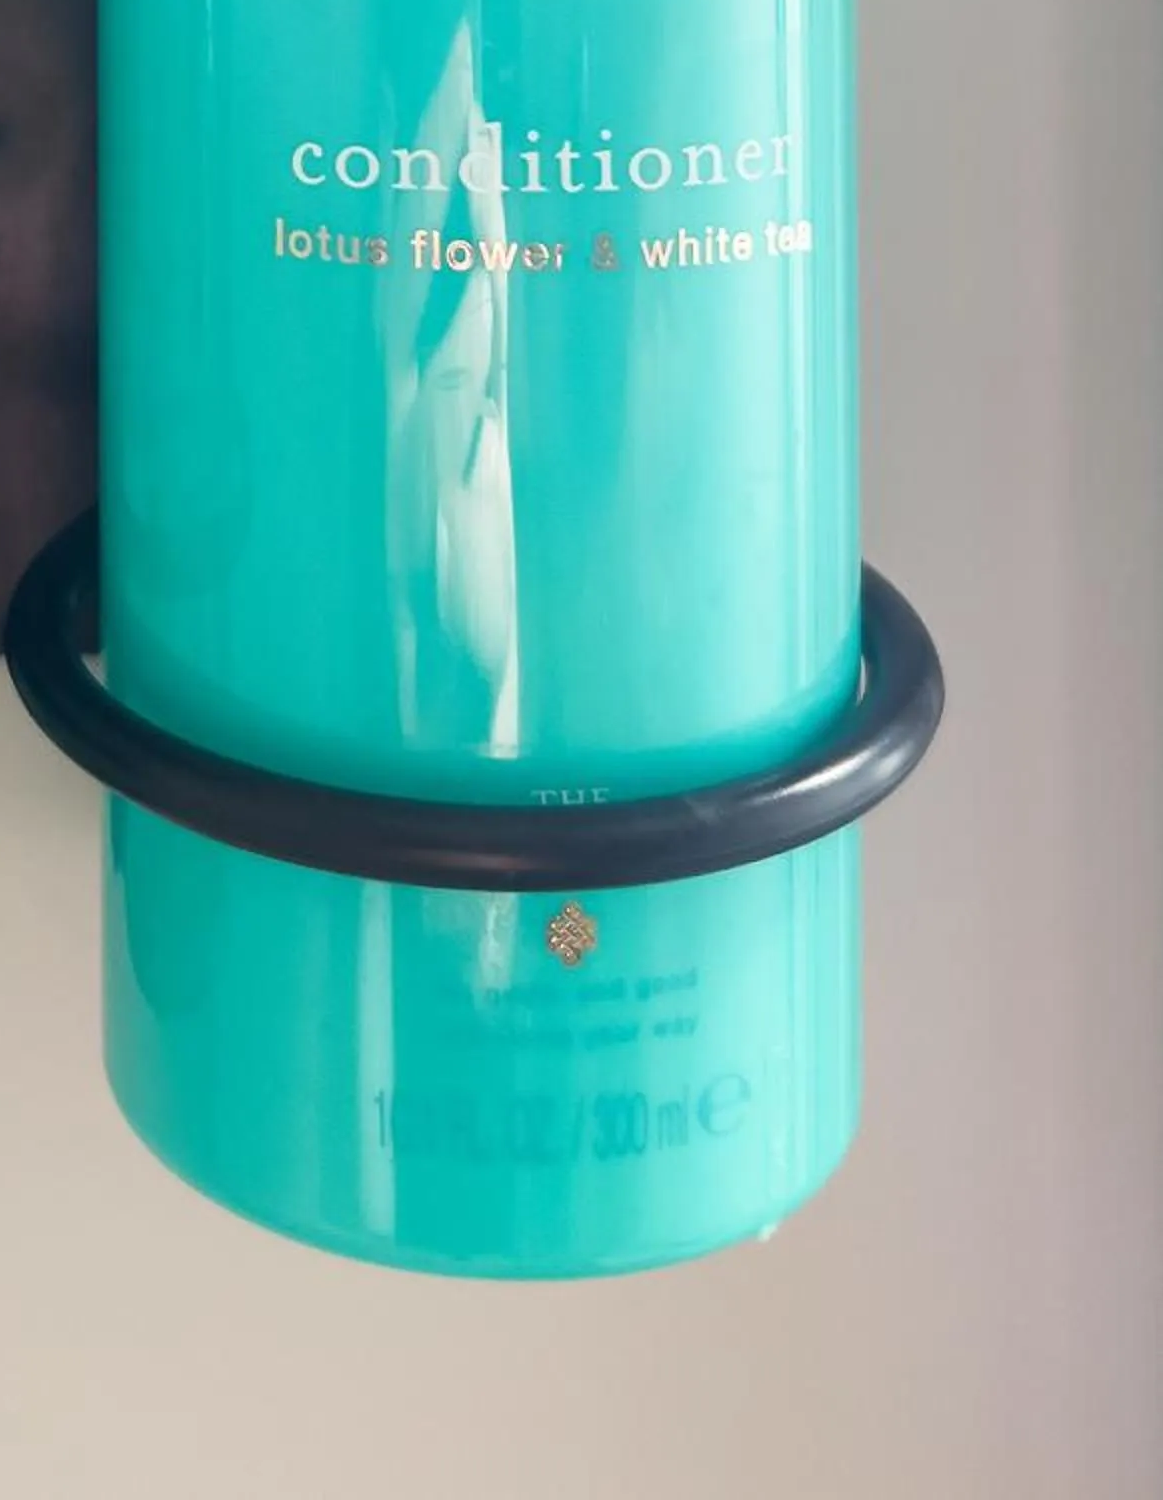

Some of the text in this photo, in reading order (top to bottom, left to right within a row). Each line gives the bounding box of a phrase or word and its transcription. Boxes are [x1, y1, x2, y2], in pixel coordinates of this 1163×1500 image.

[291, 121, 799, 194] conditioner
[275, 218, 813, 271] lotus flower & white tea
